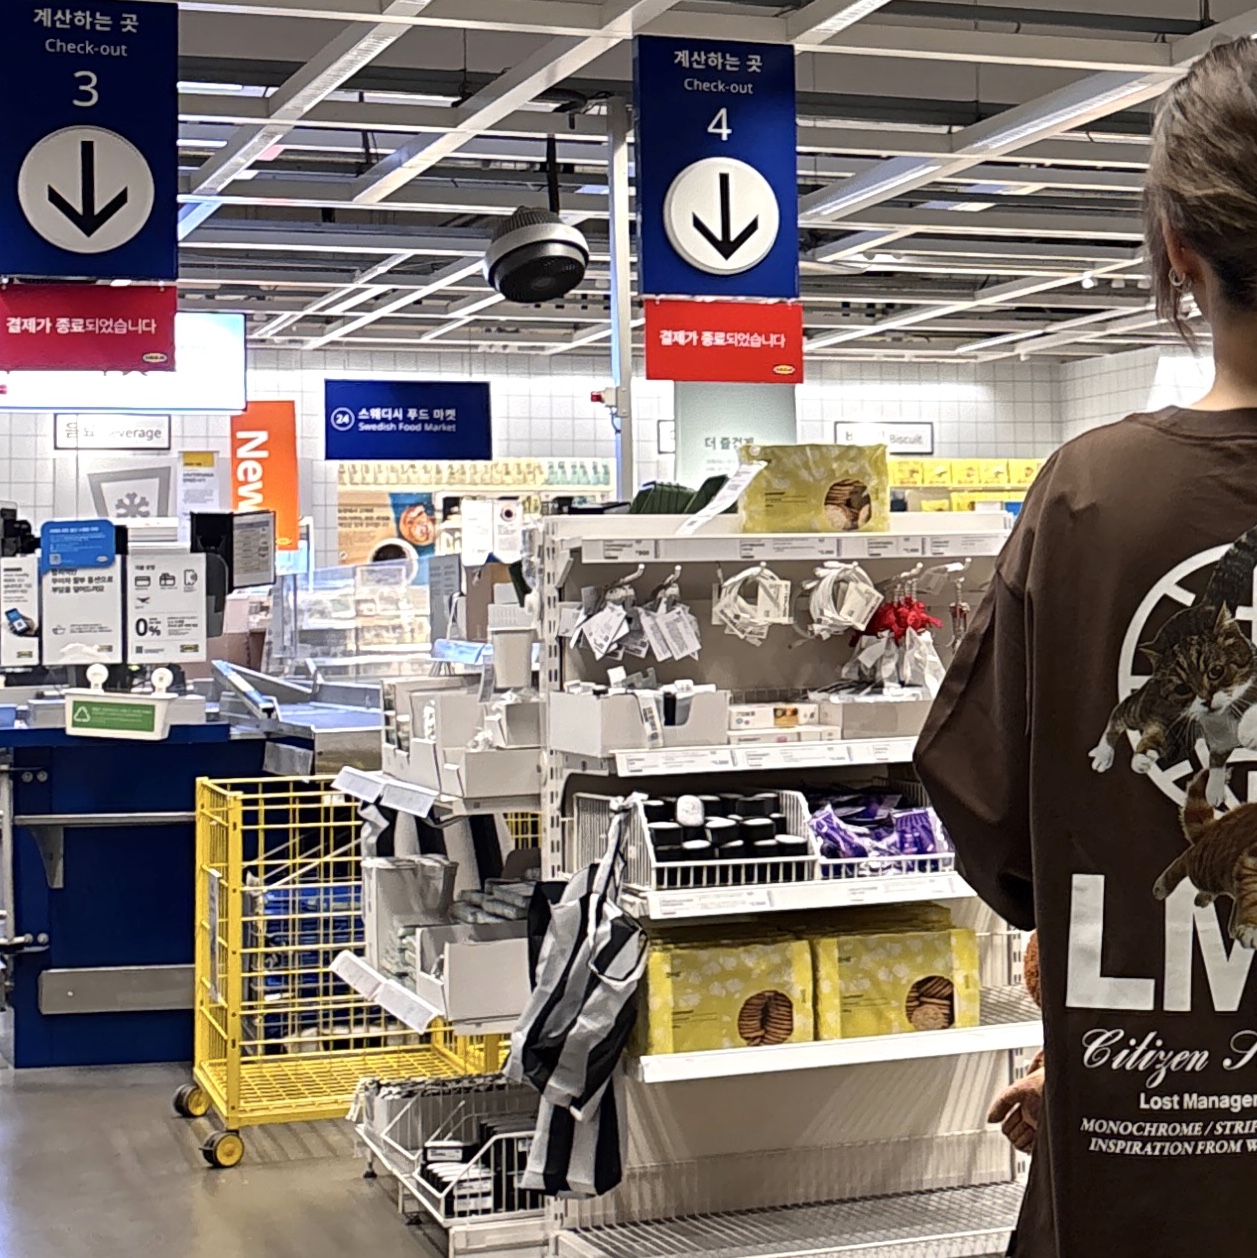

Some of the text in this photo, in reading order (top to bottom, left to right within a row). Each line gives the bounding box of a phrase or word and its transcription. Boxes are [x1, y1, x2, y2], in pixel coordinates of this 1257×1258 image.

[33, 8, 139, 33] 계산하는 곳
[45, 38, 128, 57] Check-out
[673, 49, 763, 73] 계산하는 곳
[72, 70, 99, 107] 3
[683, 78, 754, 94] Check-out
[707, 107, 732, 141] 4
[6, 317, 157, 335] 결제가 종료되었습니다
[659, 330, 786, 348] 결제가 종료되었습니다
[336, 407, 456, 424] 24 스웨디시 푸드 마켓
[358, 422, 456, 433] Swedish Food Market
[705, 437, 716, 450] 더
[889, 434, 924, 445] Biscuit
[236, 430, 269, 512] New
[1081, 1028, 1211, 1088] Citizen
[1139, 1093, 1180, 1110] Lost
[1080, 1117, 1203, 1136] MONOCHROME
[1089, 1137, 1196, 1156] INSPIRATION
[1195, 1139, 1243, 1155] FROM
